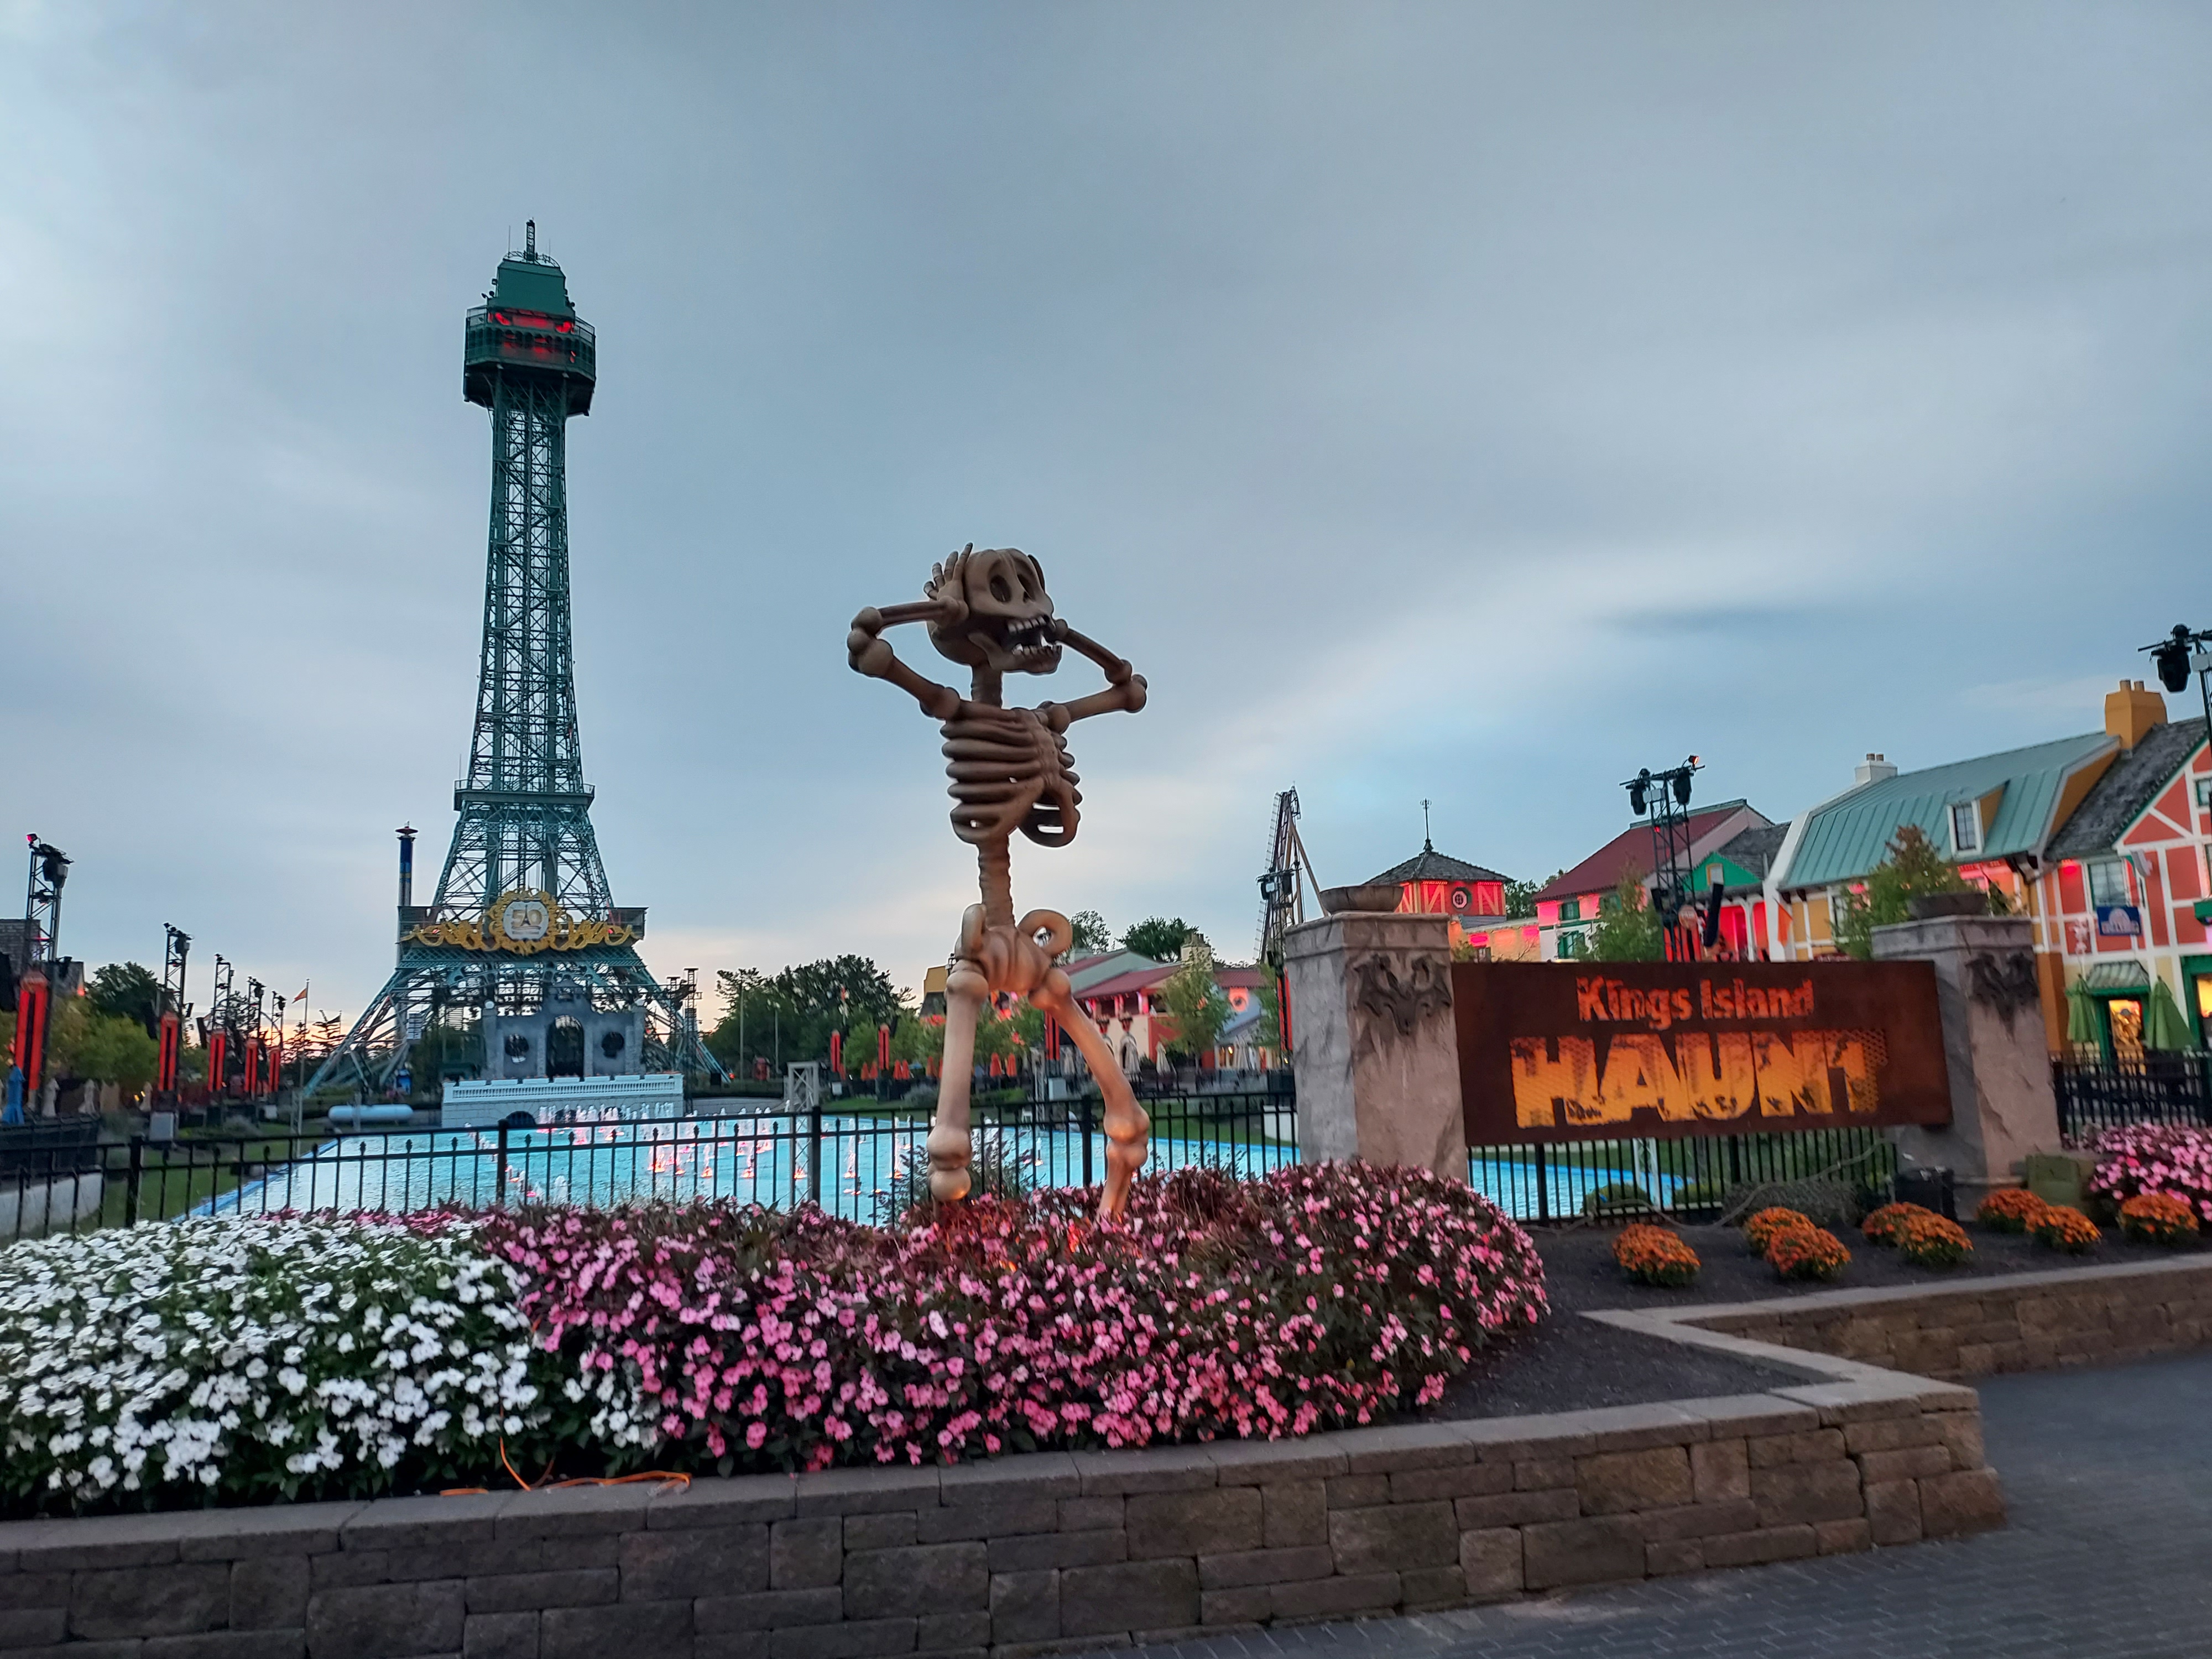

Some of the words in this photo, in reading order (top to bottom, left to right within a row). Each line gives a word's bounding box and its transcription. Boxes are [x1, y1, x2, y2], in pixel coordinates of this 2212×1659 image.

[511, 909, 542, 927] 50
[1576, 975, 1693, 1030] Kings
[1700, 978, 1814, 1020] Island
[1510, 1030, 1887, 1129] HAUNT
